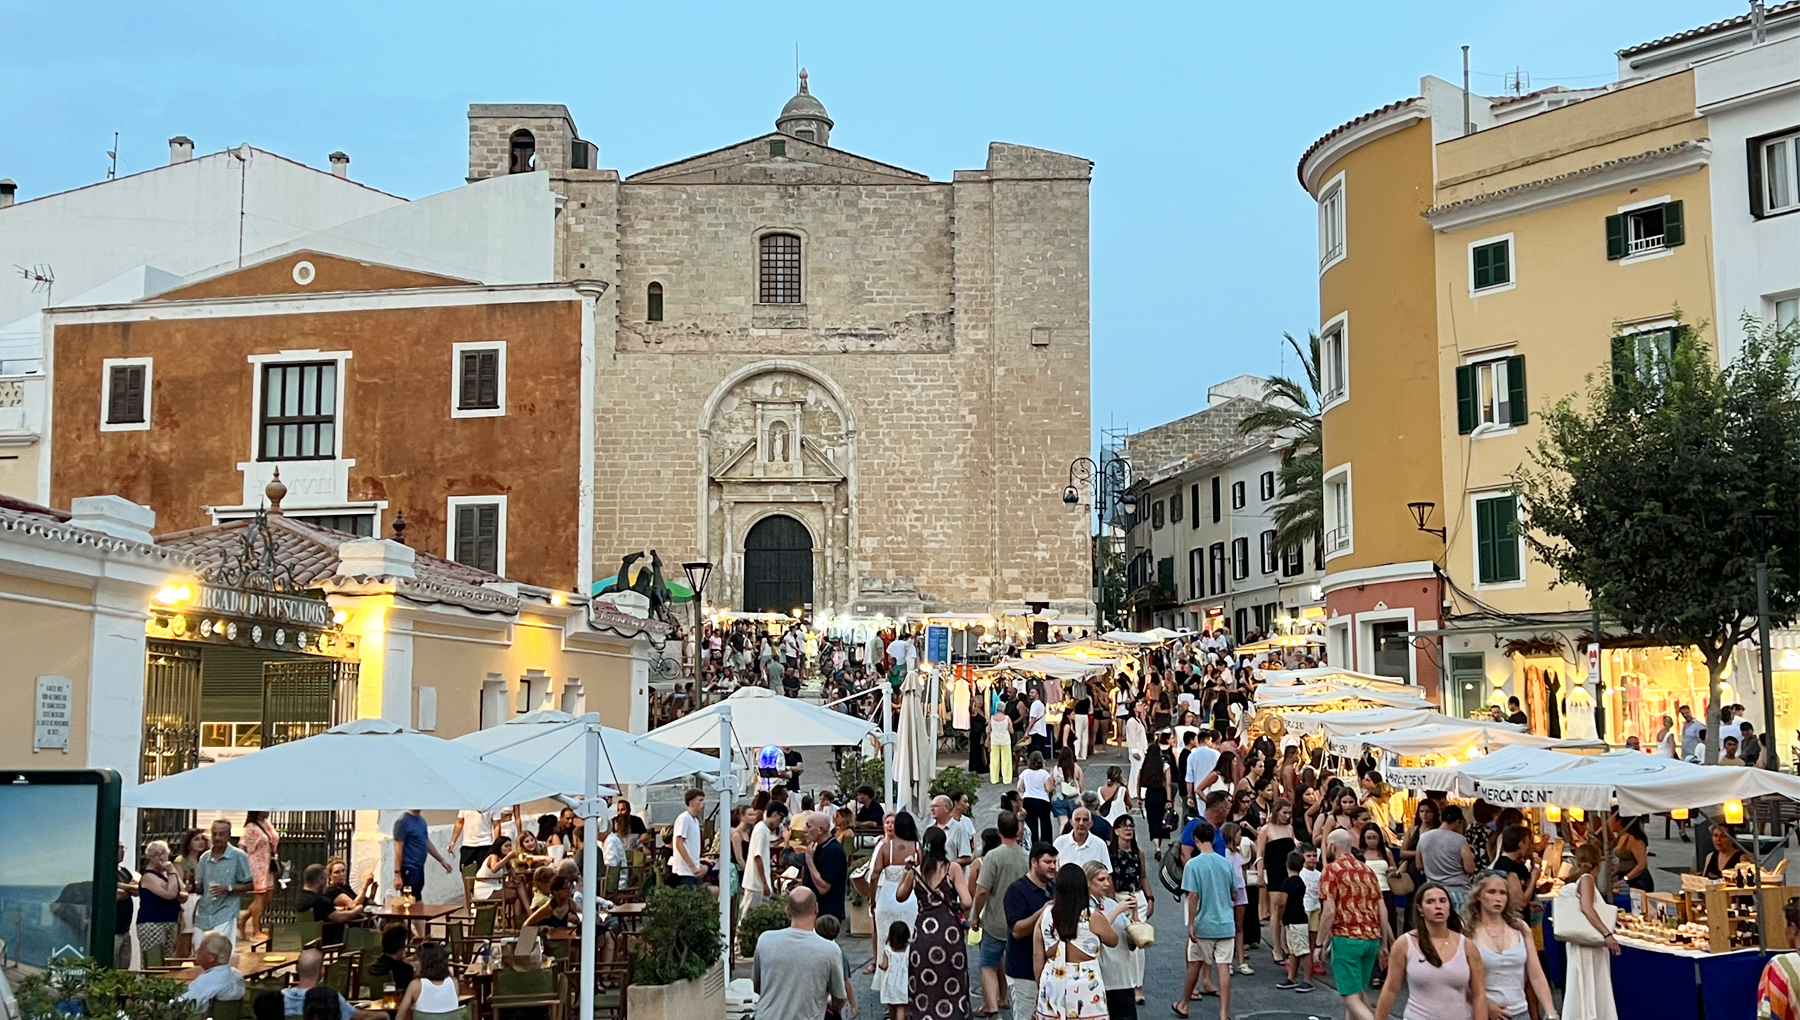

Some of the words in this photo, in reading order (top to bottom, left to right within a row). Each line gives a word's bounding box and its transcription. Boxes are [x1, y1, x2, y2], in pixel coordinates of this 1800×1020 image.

[193, 586, 248, 613] ERCADO
[249, 593, 266, 615] DE
[268, 597, 327, 624] PESCADOS
[1481, 787, 1519, 803] MERCAT
[1521, 790, 1534, 803] DE
